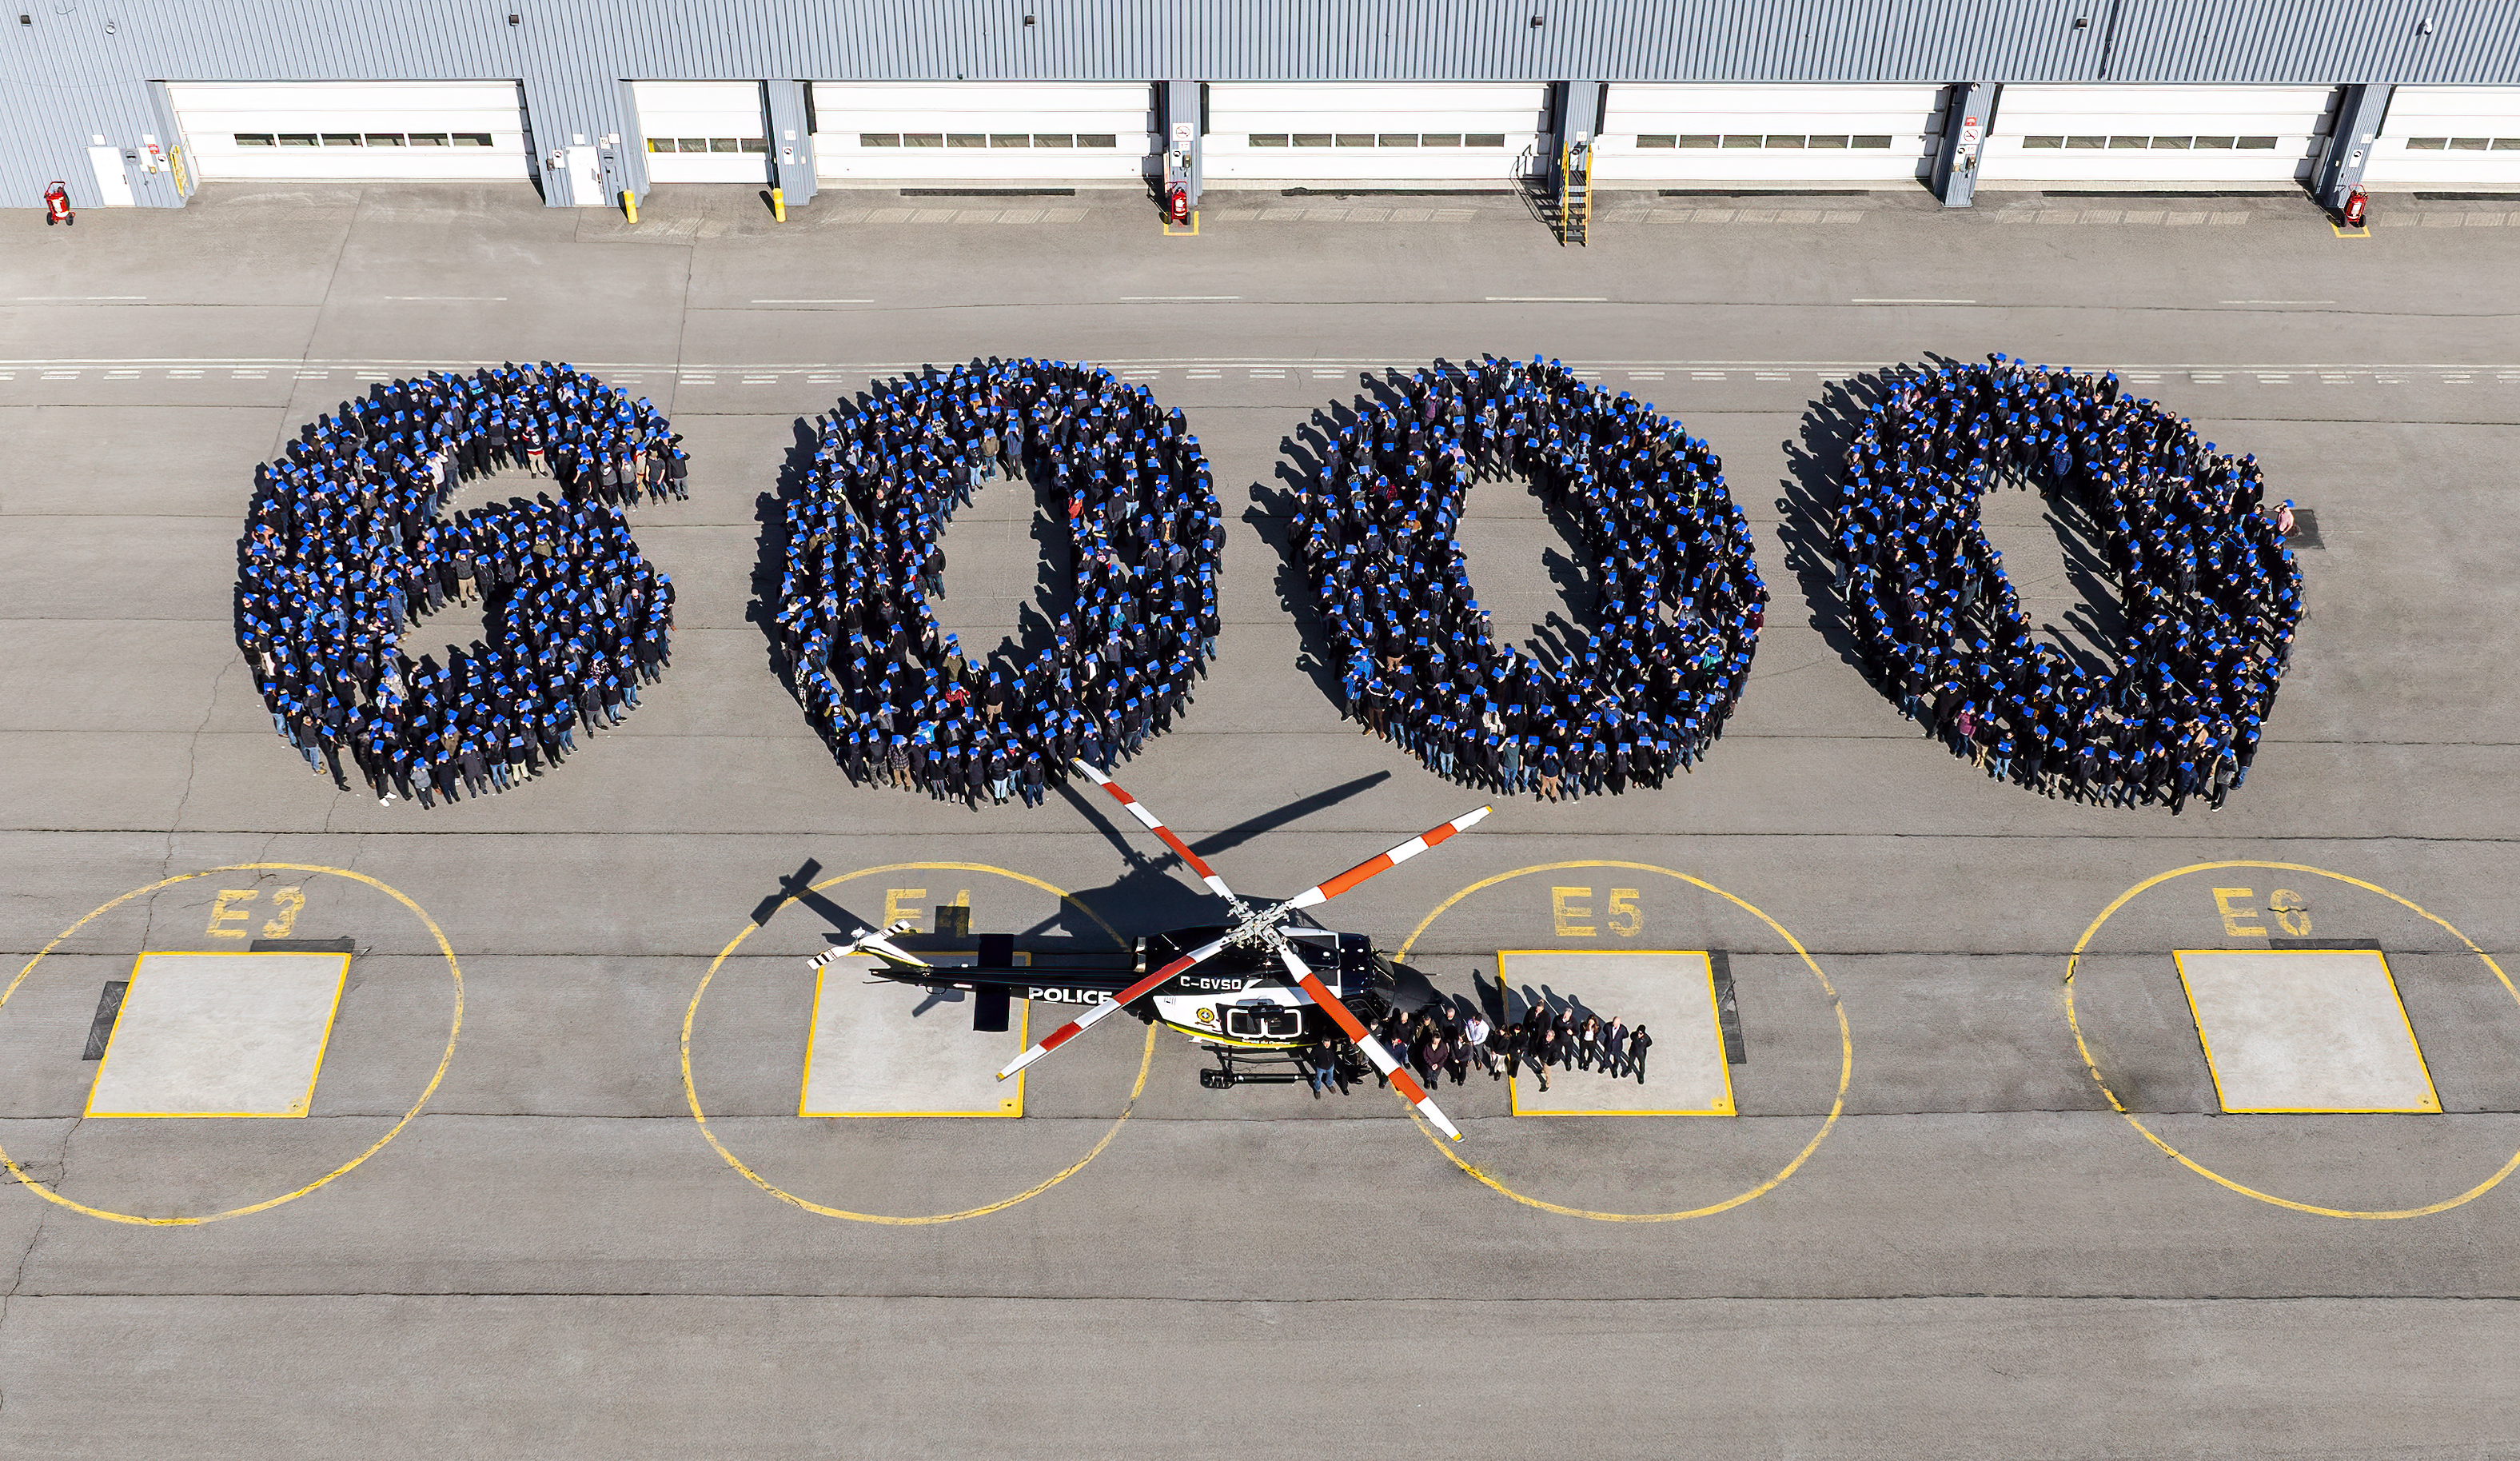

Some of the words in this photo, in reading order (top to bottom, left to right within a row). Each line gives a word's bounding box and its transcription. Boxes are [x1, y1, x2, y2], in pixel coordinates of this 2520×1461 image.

[205, 886, 305, 939] E3
[1552, 886, 1644, 937] E5
[2212, 887, 2312, 936] E6
[1028, 986, 1113, 1004] POLICE
